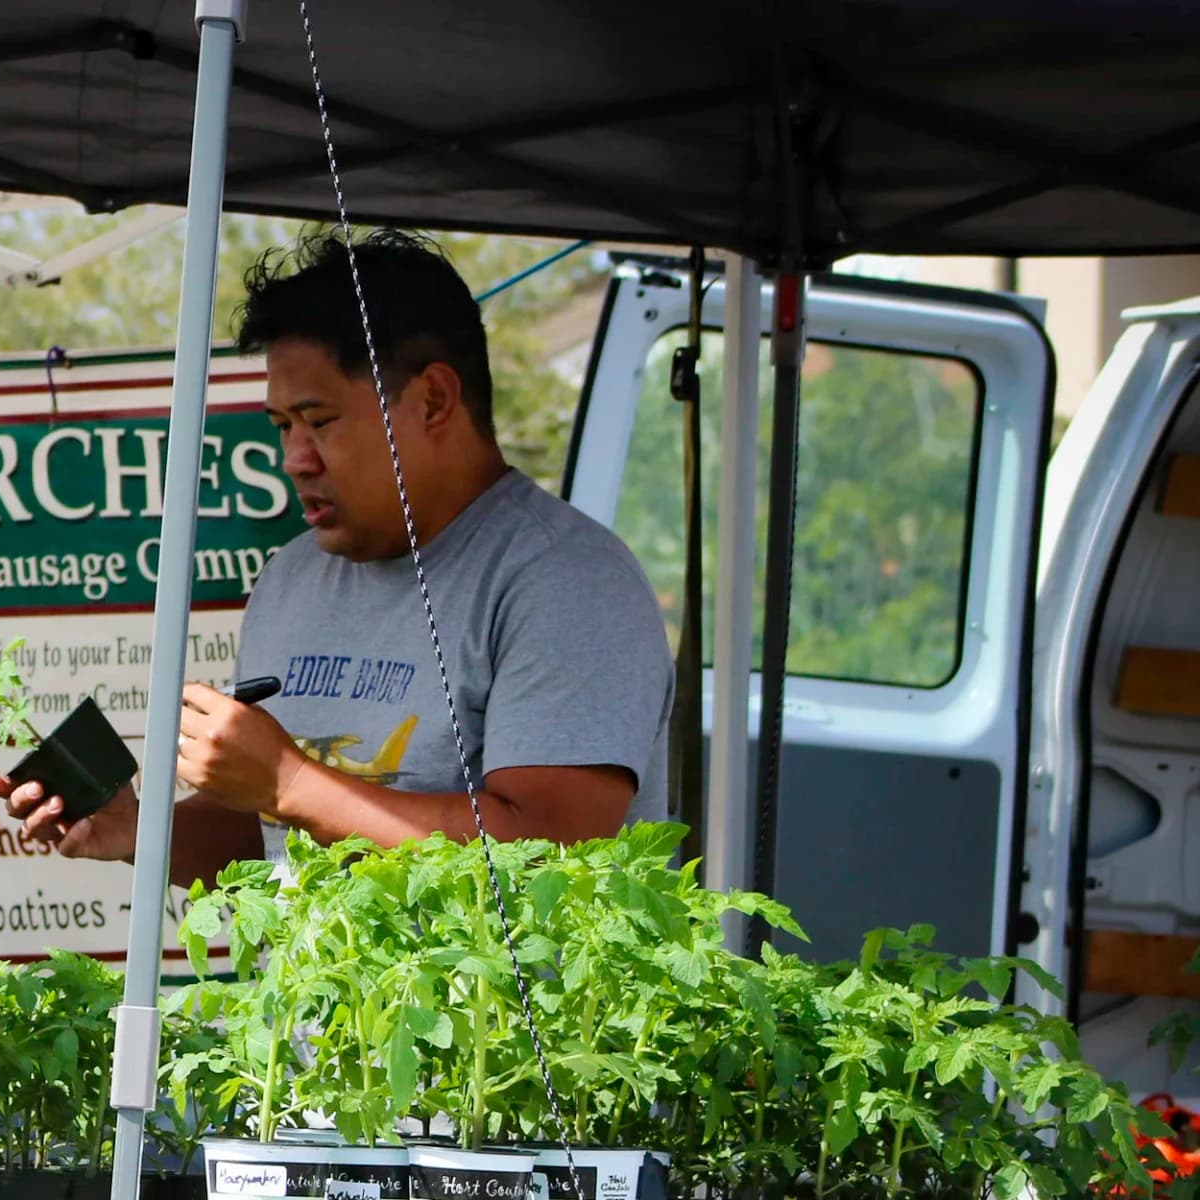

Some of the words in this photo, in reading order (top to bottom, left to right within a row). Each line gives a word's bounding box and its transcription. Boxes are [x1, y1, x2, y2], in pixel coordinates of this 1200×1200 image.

[44, 640, 62, 667] to
[67, 644, 111, 677] your
[115, 636, 153, 666] Fam
[188, 631, 238, 663] Tabl
[280, 655, 352, 699] EDDIE
[350, 657, 417, 705] BAUER
[442, 1174, 481, 1197] Hort
